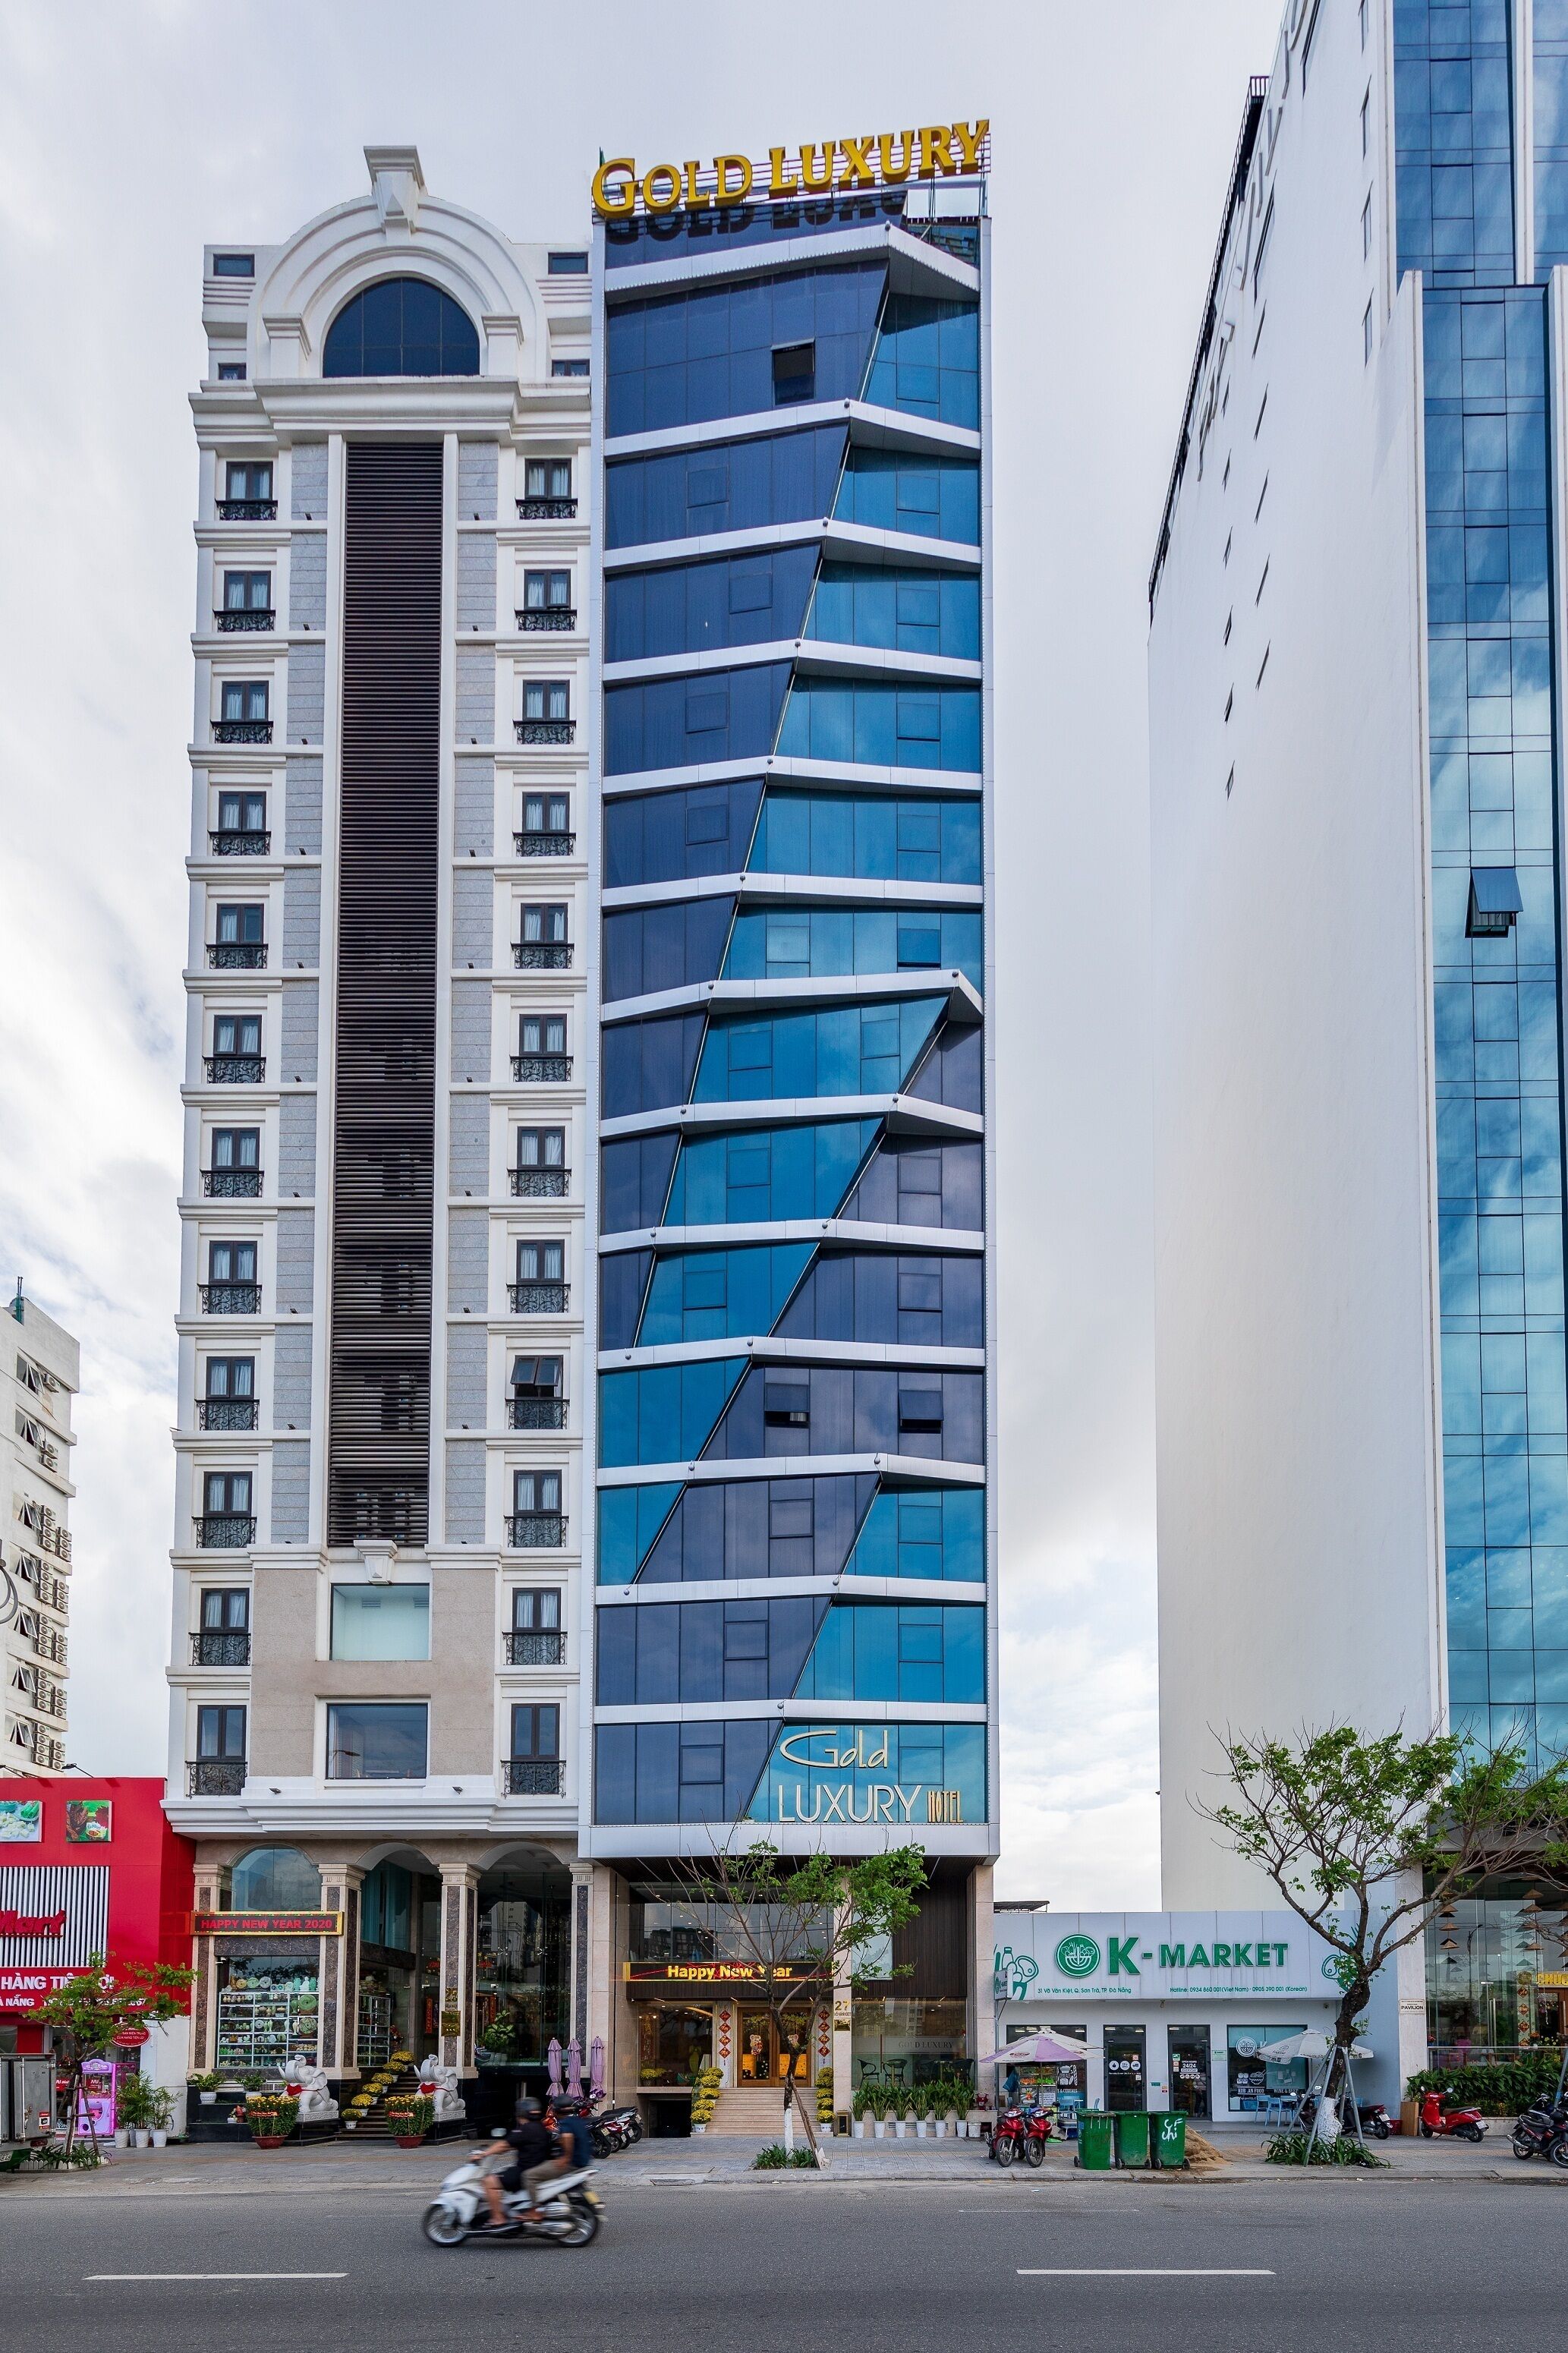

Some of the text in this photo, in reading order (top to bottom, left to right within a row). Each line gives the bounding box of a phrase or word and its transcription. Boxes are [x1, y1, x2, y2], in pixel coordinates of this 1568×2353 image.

[592, 119, 990, 219] GOLD LUXURY
[779, 1730, 888, 1769] Gold
[779, 1785, 964, 1822] LUXURY HOTEL
[201, 1919, 332, 1929] HAPPY NEW YEAR 2020
[668, 1965, 716, 1980] Happy
[719, 1965, 754, 1977] New
[2, 1973, 46, 1989] HÀNG
[5, 1994, 35, 2006] NẴNG
[835, 2001, 849, 2011] 27
